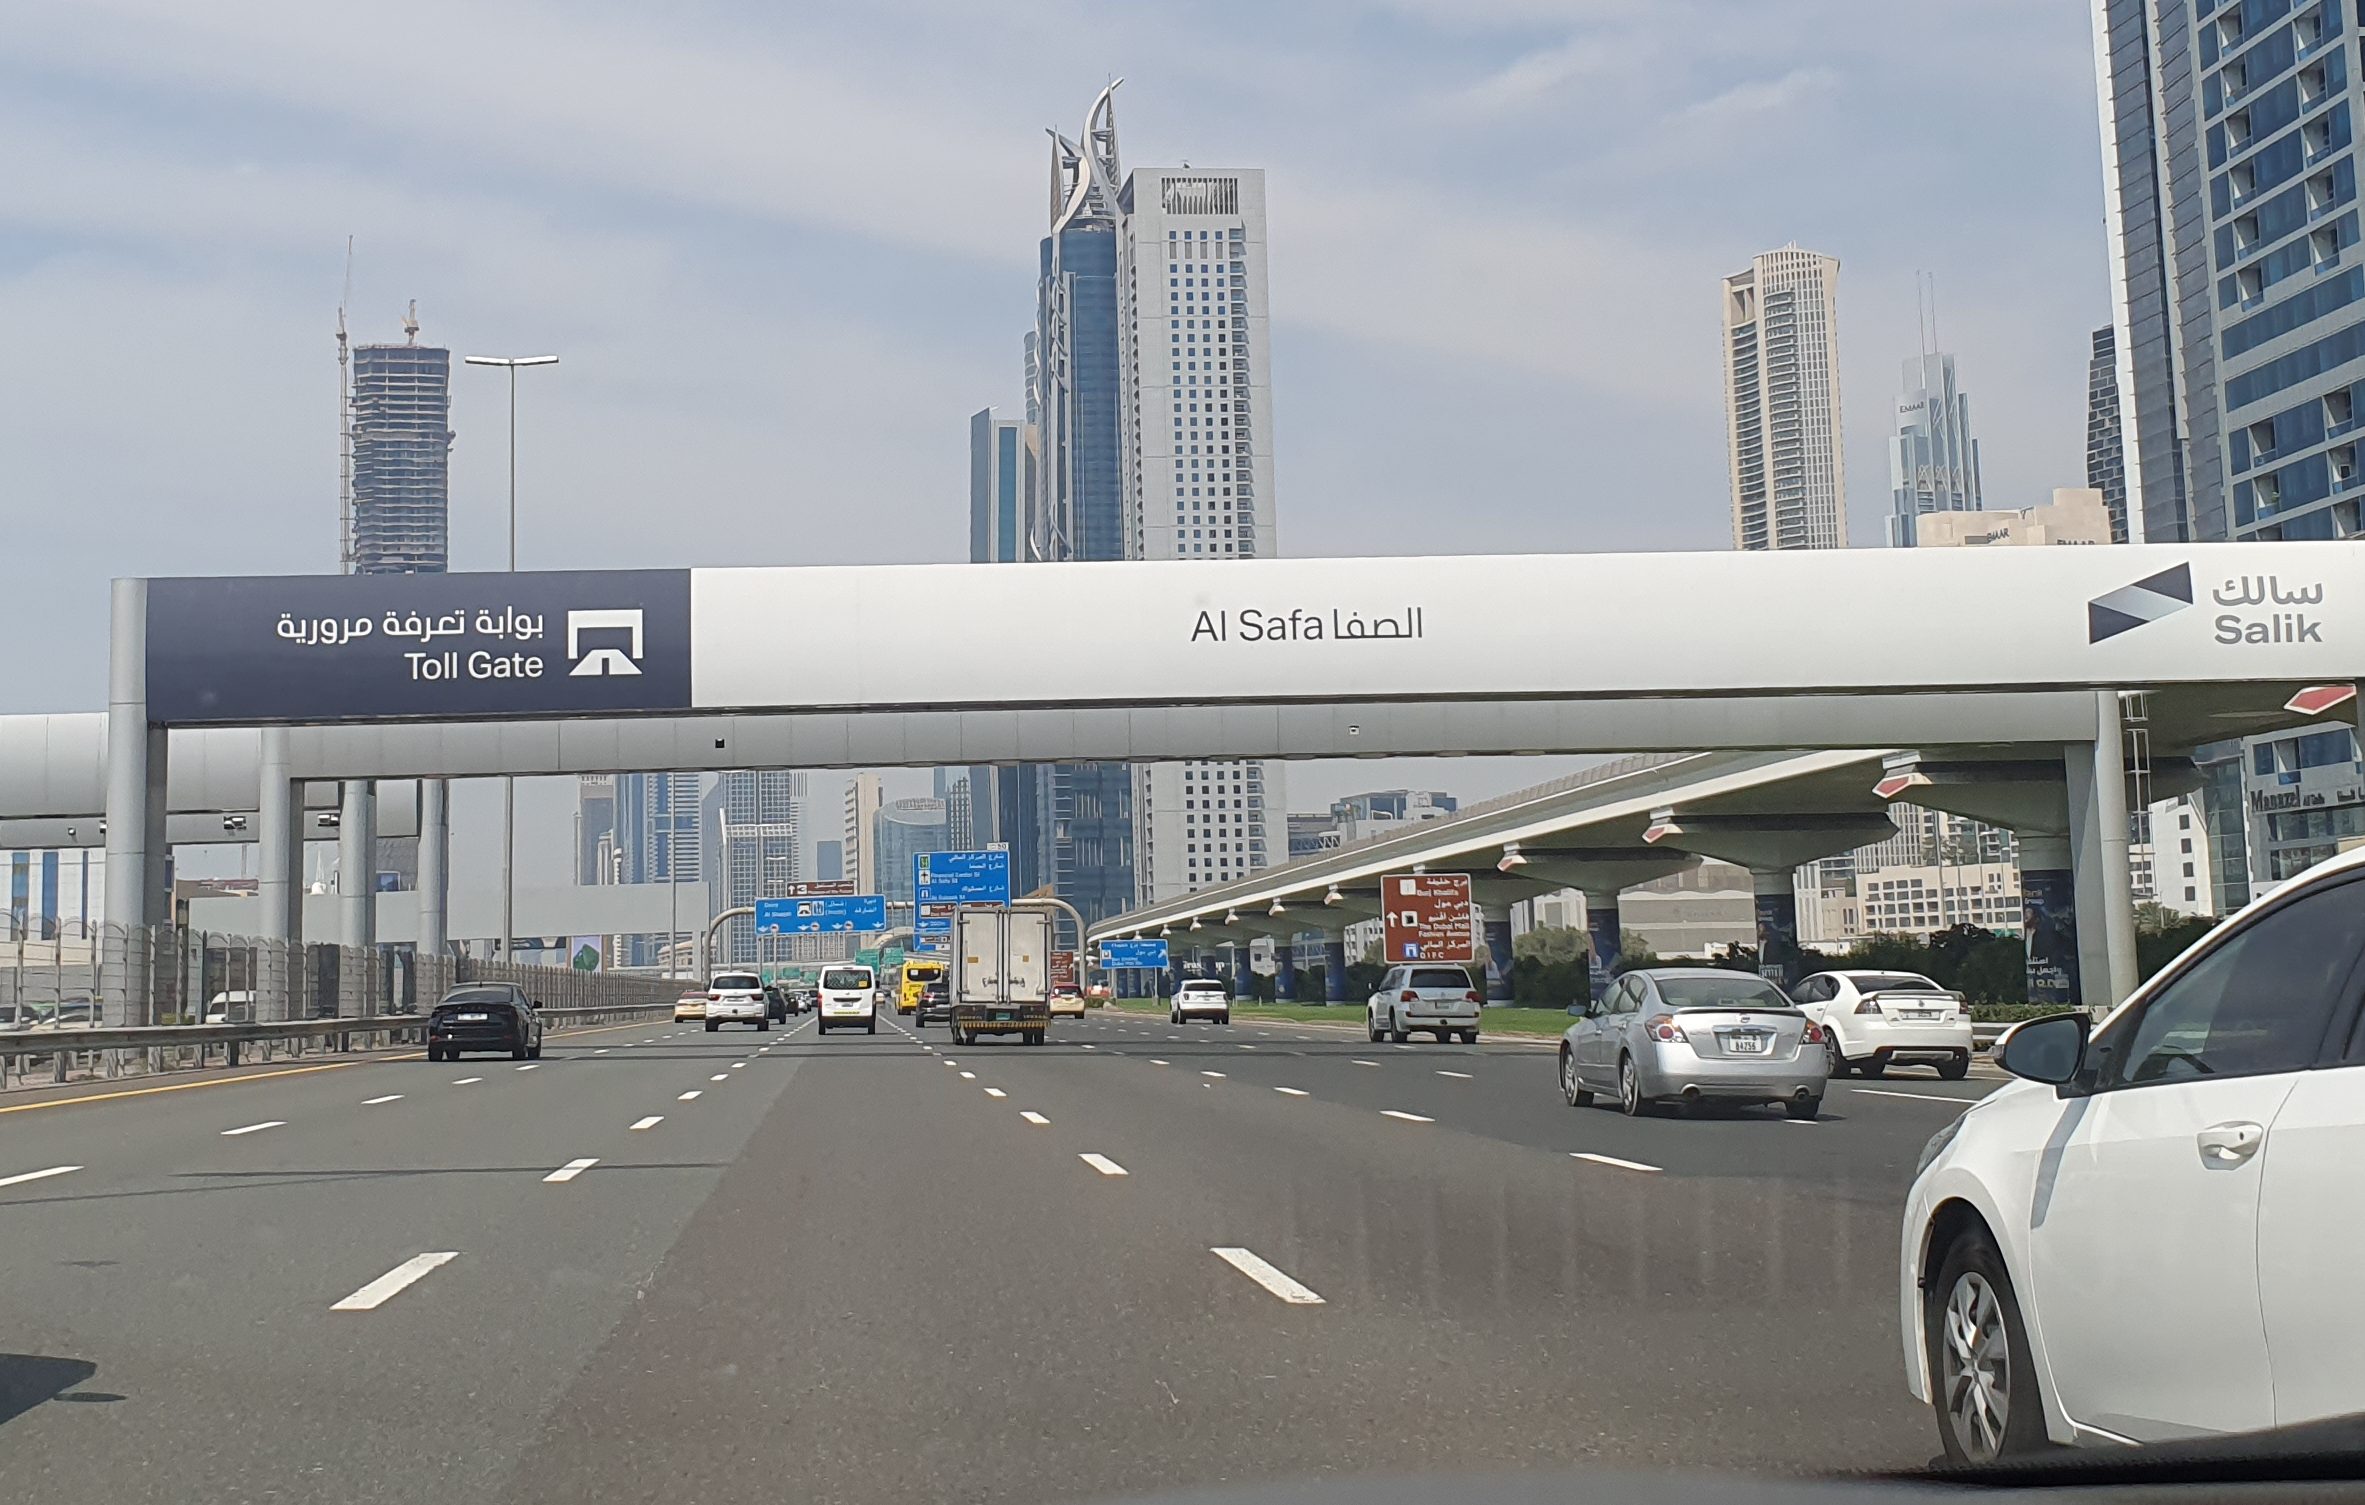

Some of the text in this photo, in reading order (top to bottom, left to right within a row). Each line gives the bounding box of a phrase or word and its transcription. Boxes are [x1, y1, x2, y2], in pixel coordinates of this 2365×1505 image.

[2212, 575, 2323, 607] سالك
[276, 605, 544, 645] بوابة تعرفة مرورية
[1190, 608, 1323, 642] Al Safa
[1333, 607, 1422, 639] الصفا
[2214, 613, 2324, 645] Salik
[404, 650, 544, 681] Toll Gate
